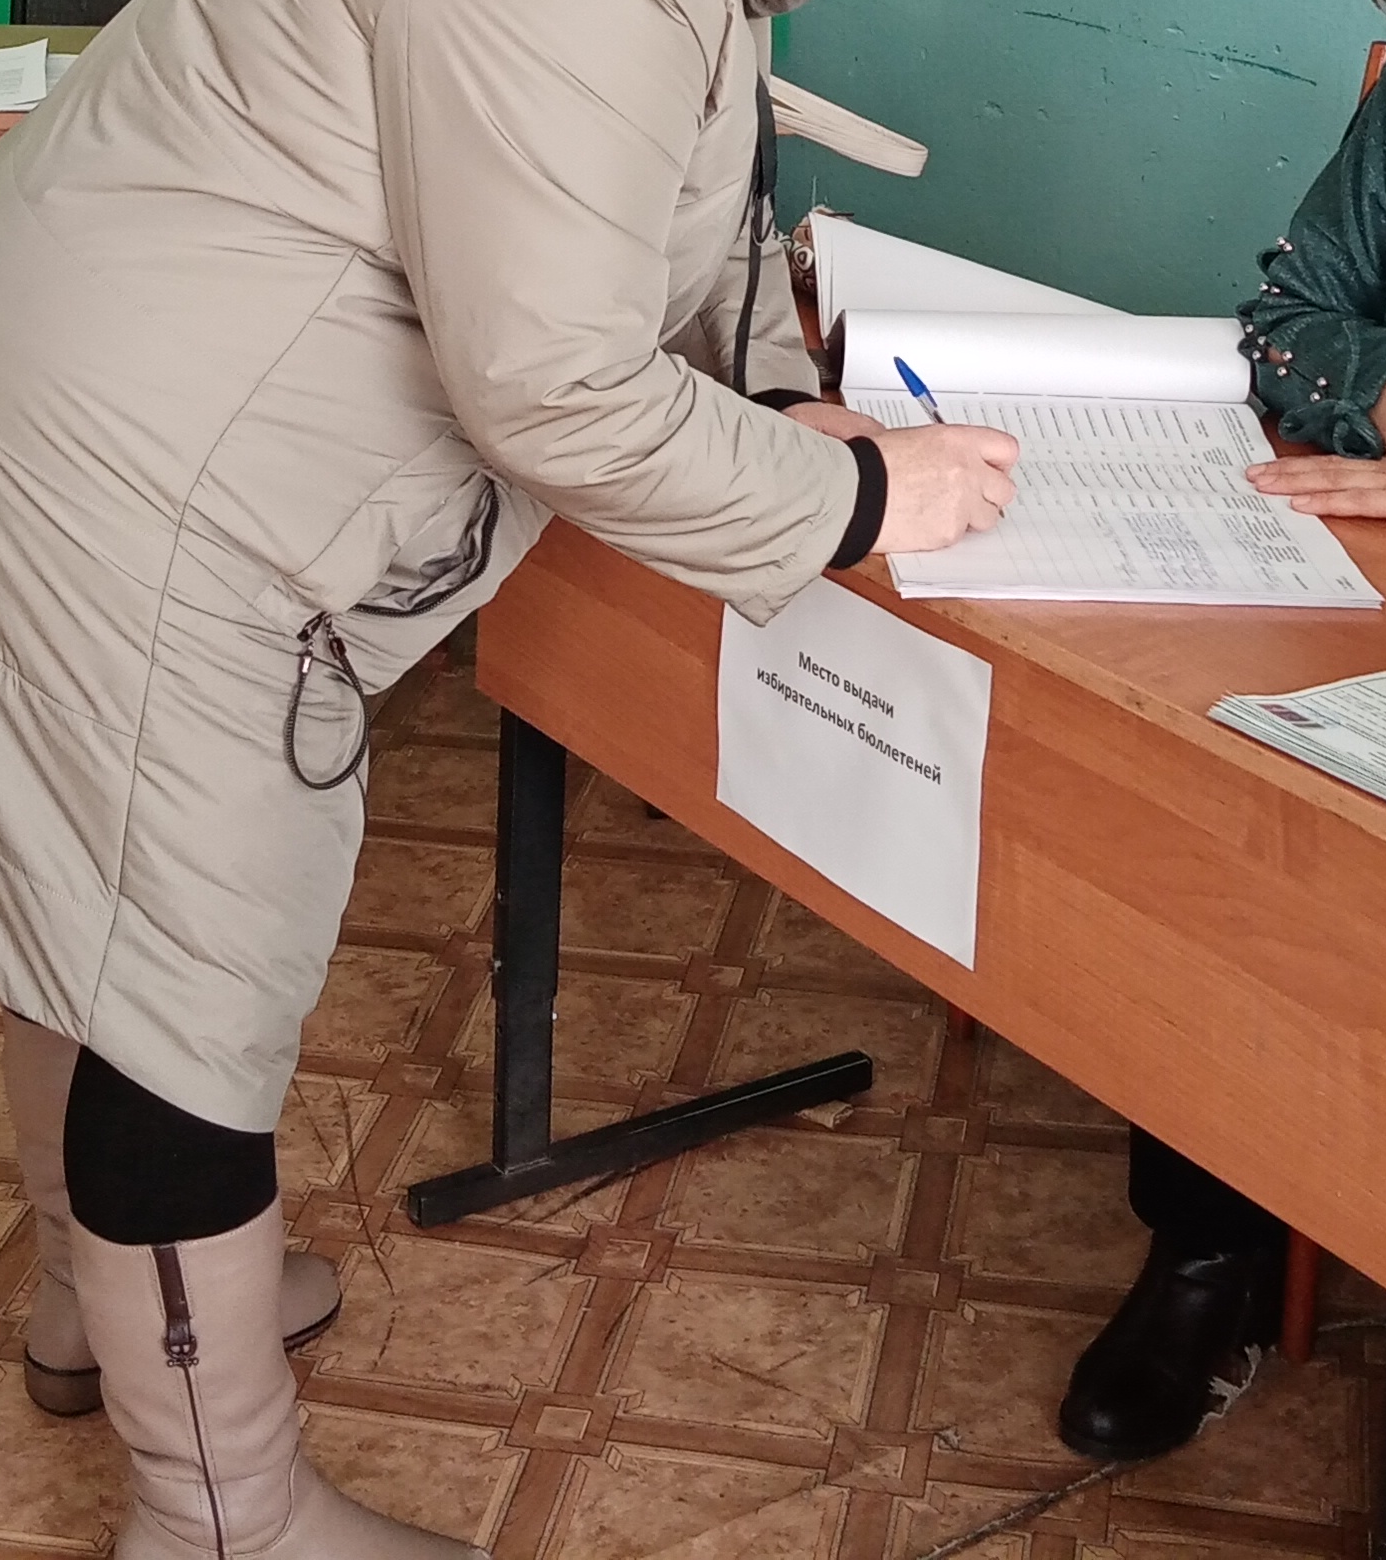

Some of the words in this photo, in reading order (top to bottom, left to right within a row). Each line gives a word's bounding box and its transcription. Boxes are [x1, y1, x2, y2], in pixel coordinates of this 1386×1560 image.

[756, 667, 855, 735] избирательных
[857, 723, 942, 786] бюллетеней
[798, 651, 840, 687] Место
[843, 679, 895, 719] выдачи
